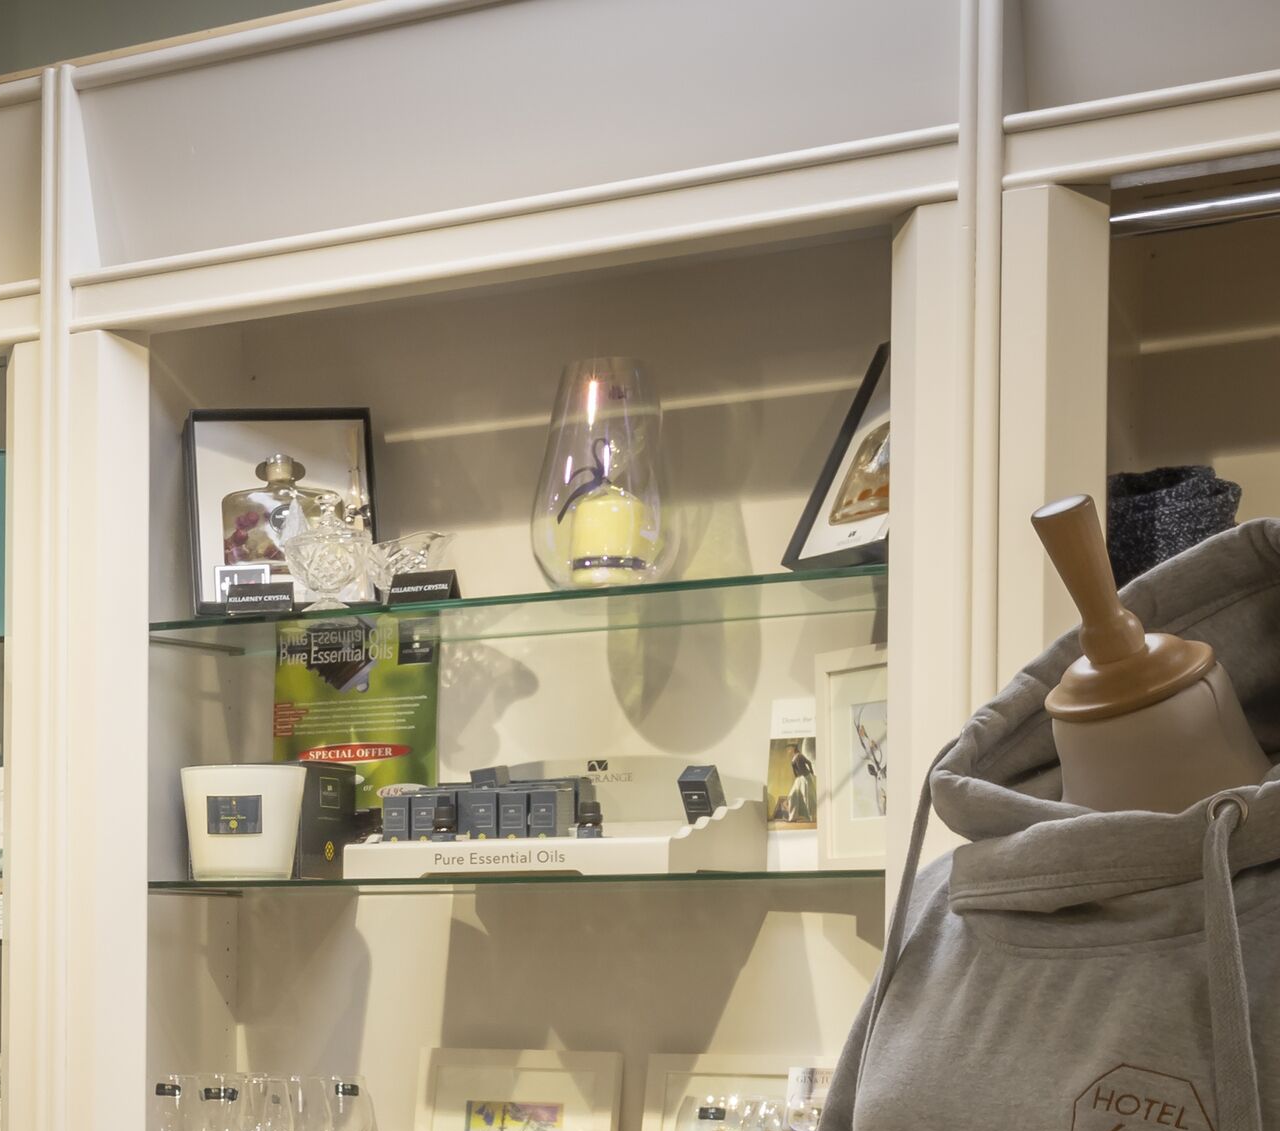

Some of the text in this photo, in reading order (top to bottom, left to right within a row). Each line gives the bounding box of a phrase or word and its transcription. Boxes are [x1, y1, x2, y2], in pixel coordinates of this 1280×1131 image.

[391, 583, 449, 594] KILLARNEY CRYSTAL
[228, 594, 290, 603] KILLARNEY CRYSTAL
[279, 649, 308, 666] Pure
[311, 643, 365, 665] Essential
[368, 643, 393, 661] Oils
[309, 748, 393, 760] SPECIAL OFFER
[434, 850, 566, 866] Pure Essential Oils
[1092, 1086, 1189, 1131] HOTEL
